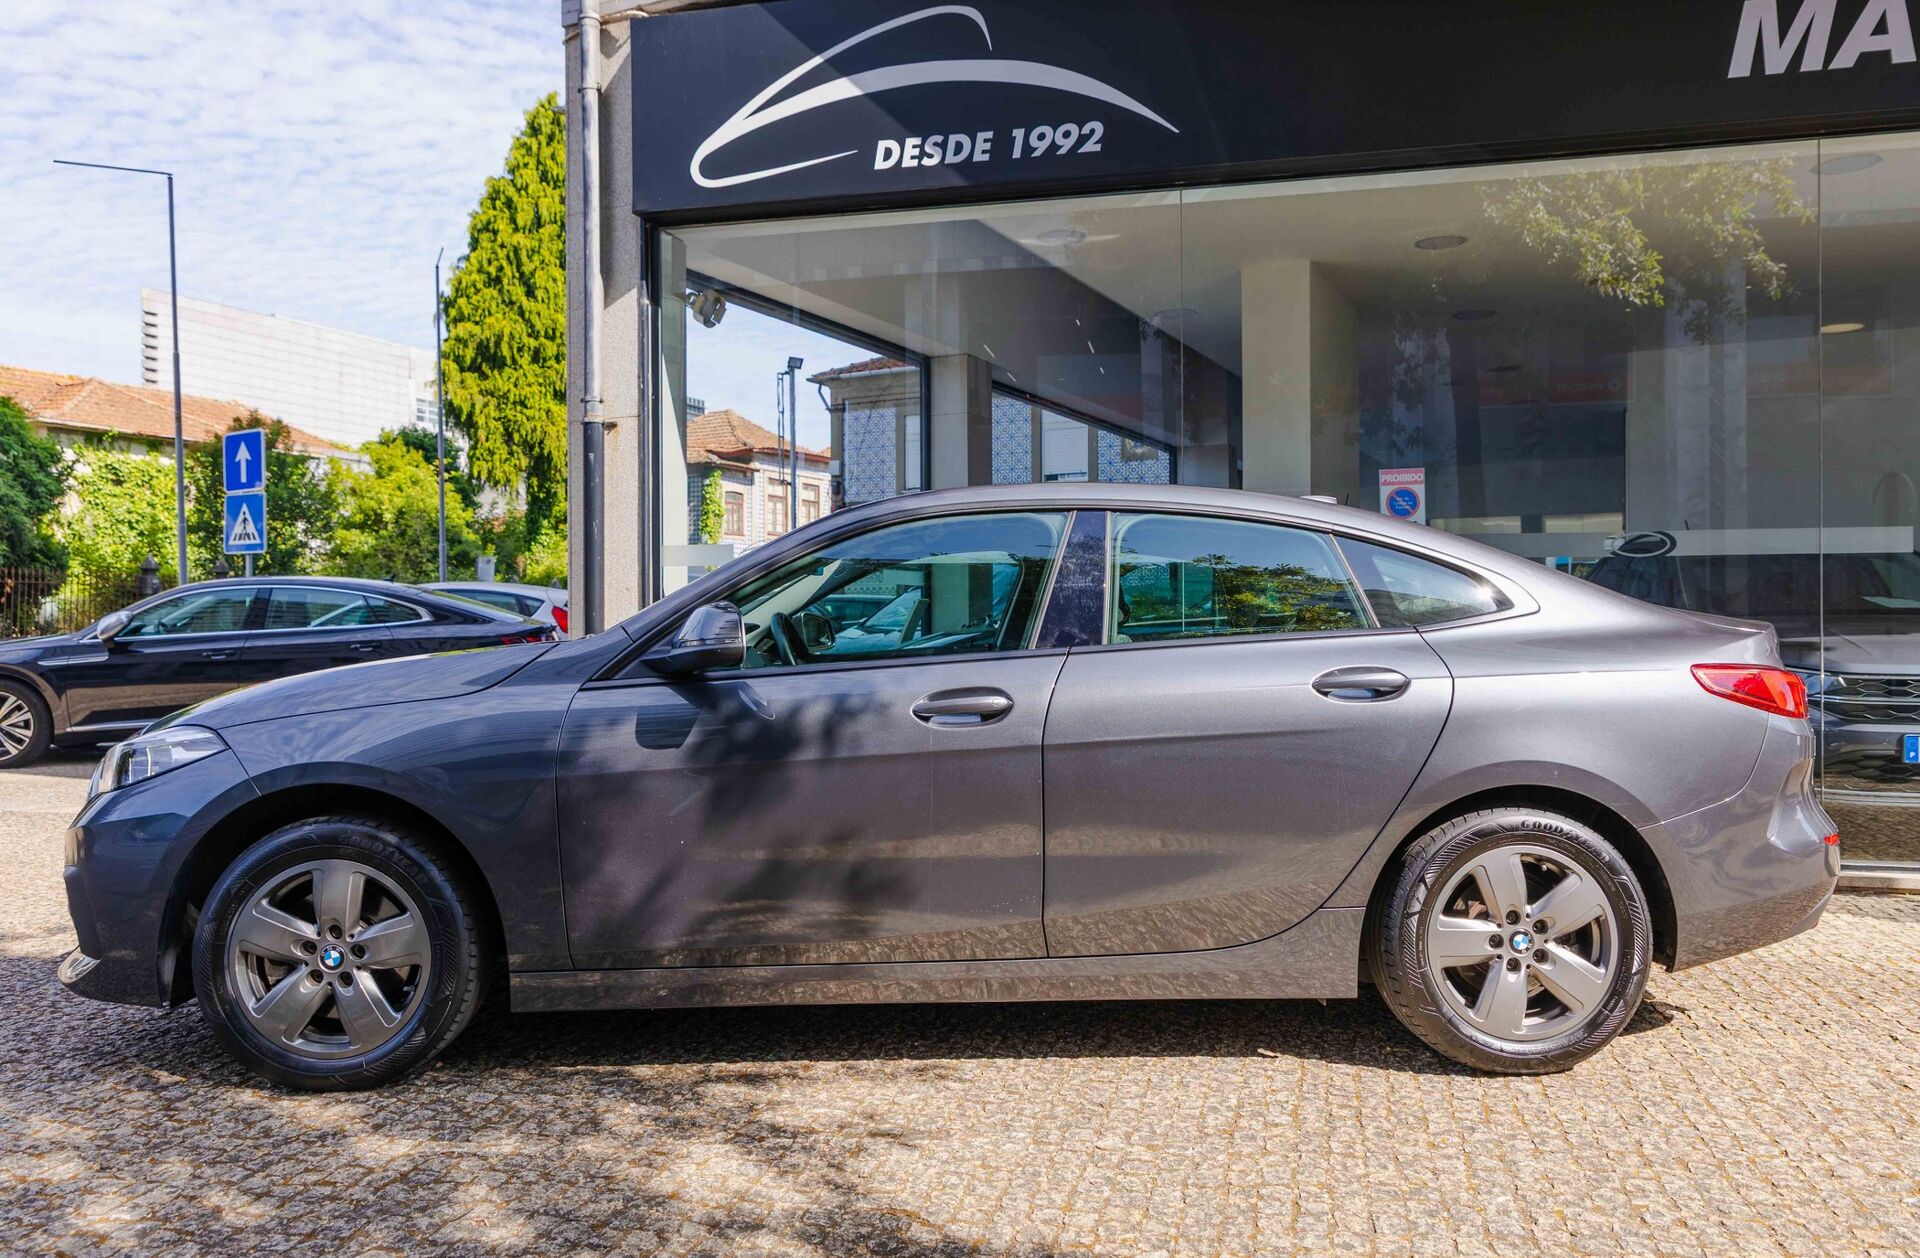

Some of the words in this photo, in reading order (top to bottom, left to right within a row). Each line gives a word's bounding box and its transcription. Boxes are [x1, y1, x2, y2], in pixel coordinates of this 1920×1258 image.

[1727, 0, 1917, 79] MA
[874, 131, 994, 170] DESDE
[1012, 120, 1105, 159] 1992
[1381, 473, 1424, 483] PROIBIDO
